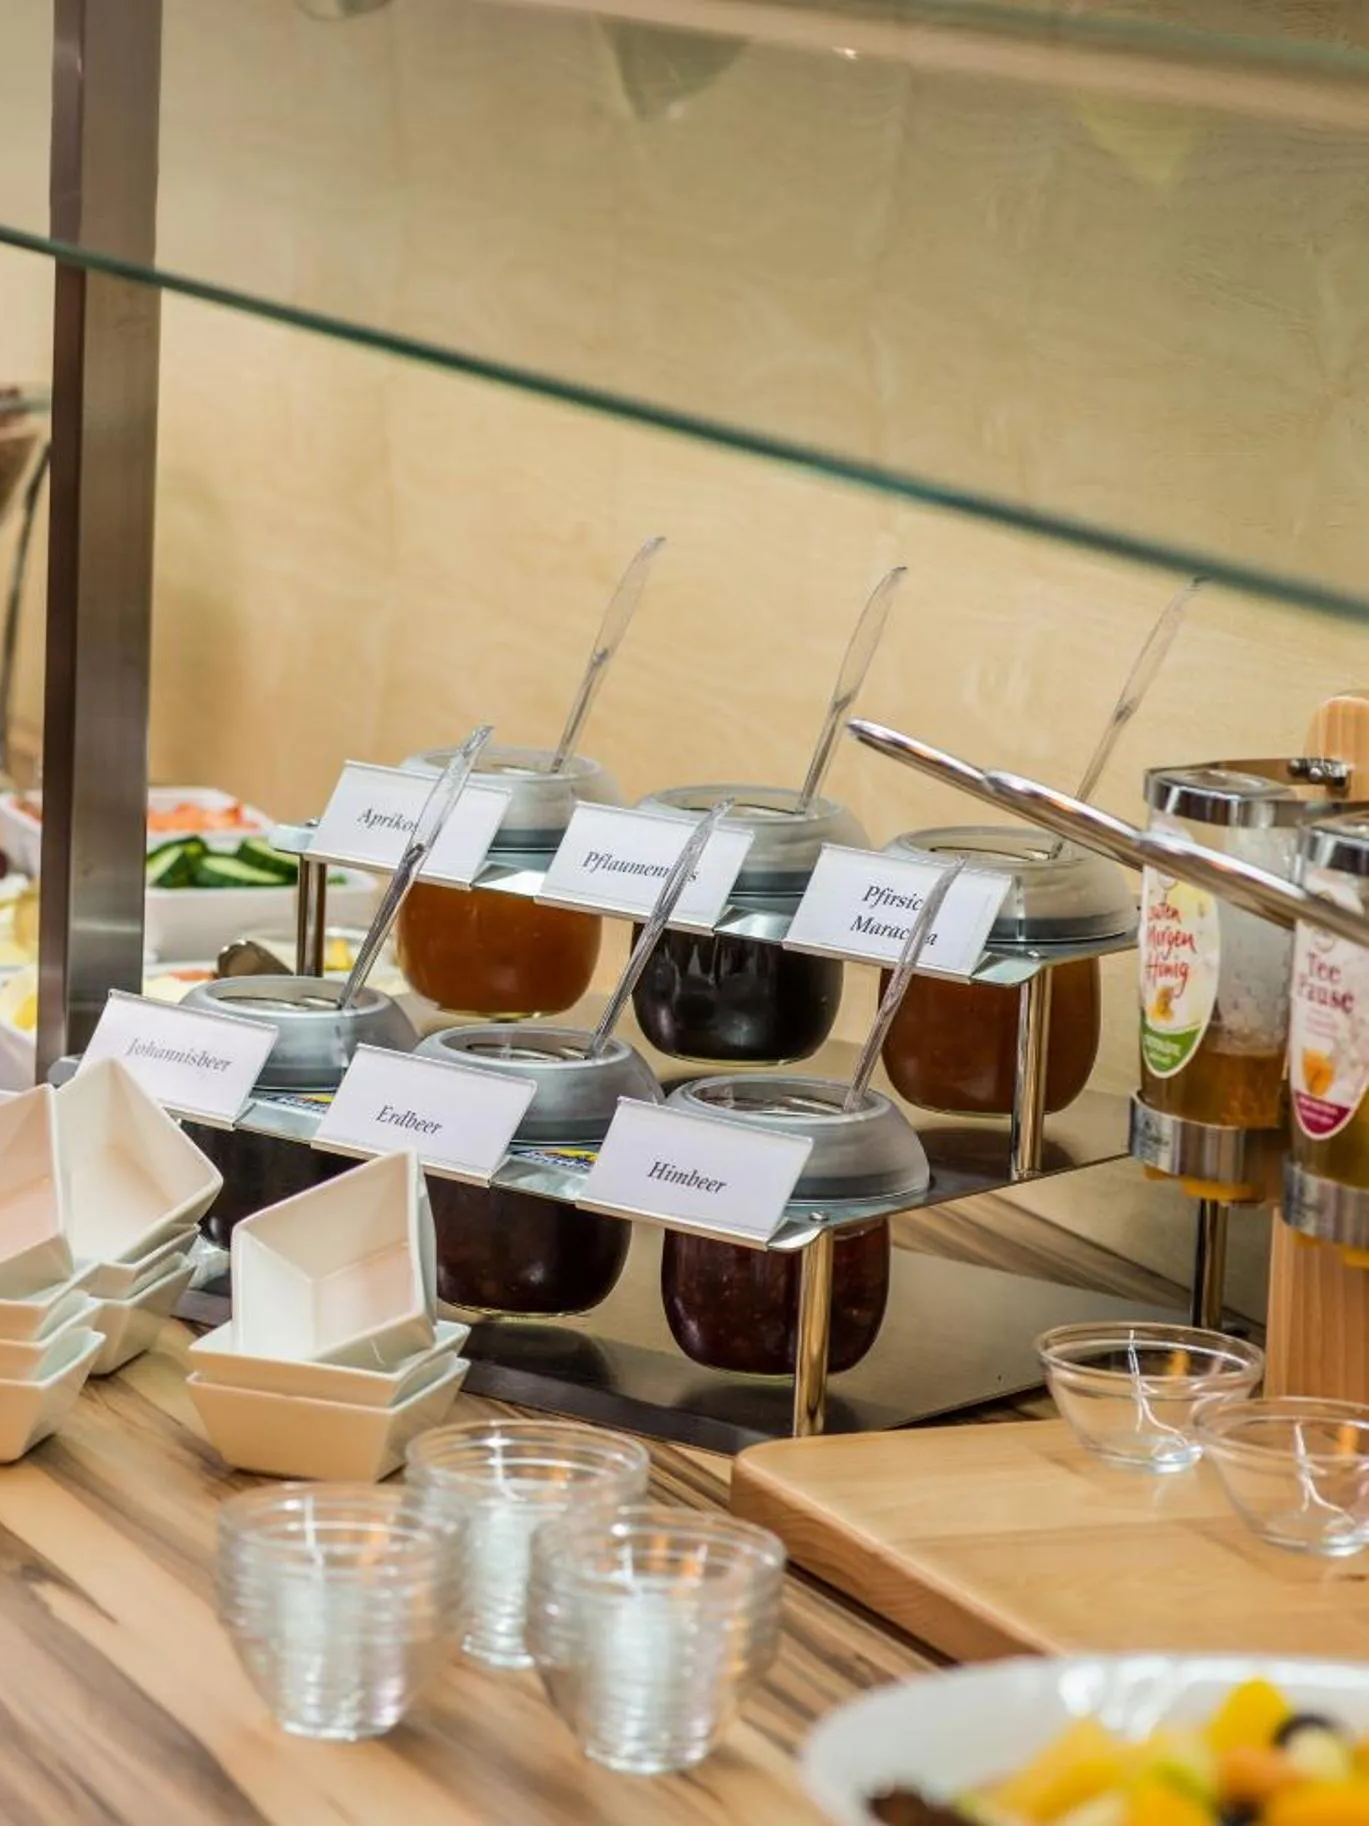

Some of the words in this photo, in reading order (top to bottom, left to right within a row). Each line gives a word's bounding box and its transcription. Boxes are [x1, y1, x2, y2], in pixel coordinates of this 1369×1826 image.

[356, 808, 420, 837] Apriko
[861, 884, 925, 911] Pfirsic
[850, 914, 938, 946] Maraca
[126, 1037, 234, 1073] Johannisbeer
[376, 1104, 443, 1136] Erdbeer
[647, 1160, 728, 1194] Himbeer
